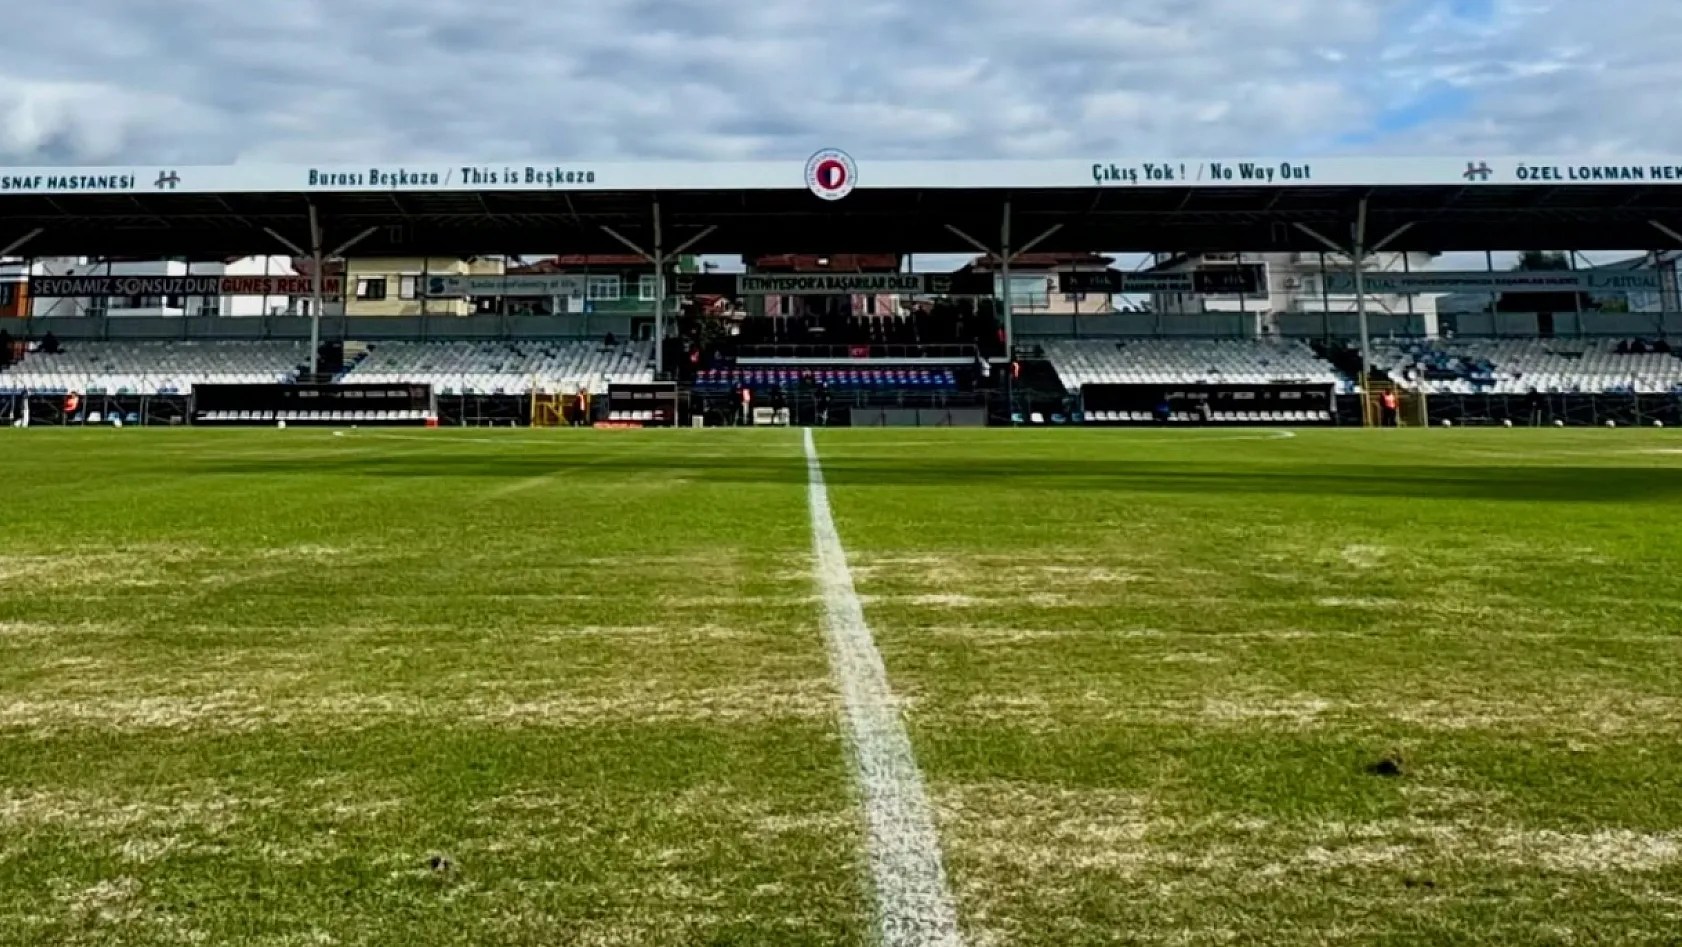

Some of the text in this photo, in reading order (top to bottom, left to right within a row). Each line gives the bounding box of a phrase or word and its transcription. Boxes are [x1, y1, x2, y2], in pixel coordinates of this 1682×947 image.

[0, 170, 135, 189] SNAF HASTANESİ
[308, 169, 363, 186] Burası
[369, 168, 439, 188] Beşkaza
[461, 167, 497, 184] This
[503, 167, 518, 184] is
[524, 167, 595, 187] Beşkaza
[1092, 163, 1138, 184] Çıkış
[1143, 163, 1174, 180] Yok
[1211, 162, 1233, 180] No
[1239, 162, 1274, 182] Way
[1281, 162, 1311, 179] Out
[1516, 163, 1562, 180] ÖZEL
[1569, 166, 1643, 180] LOKMAN
[34, 278, 110, 295] SEVDAMIZ
